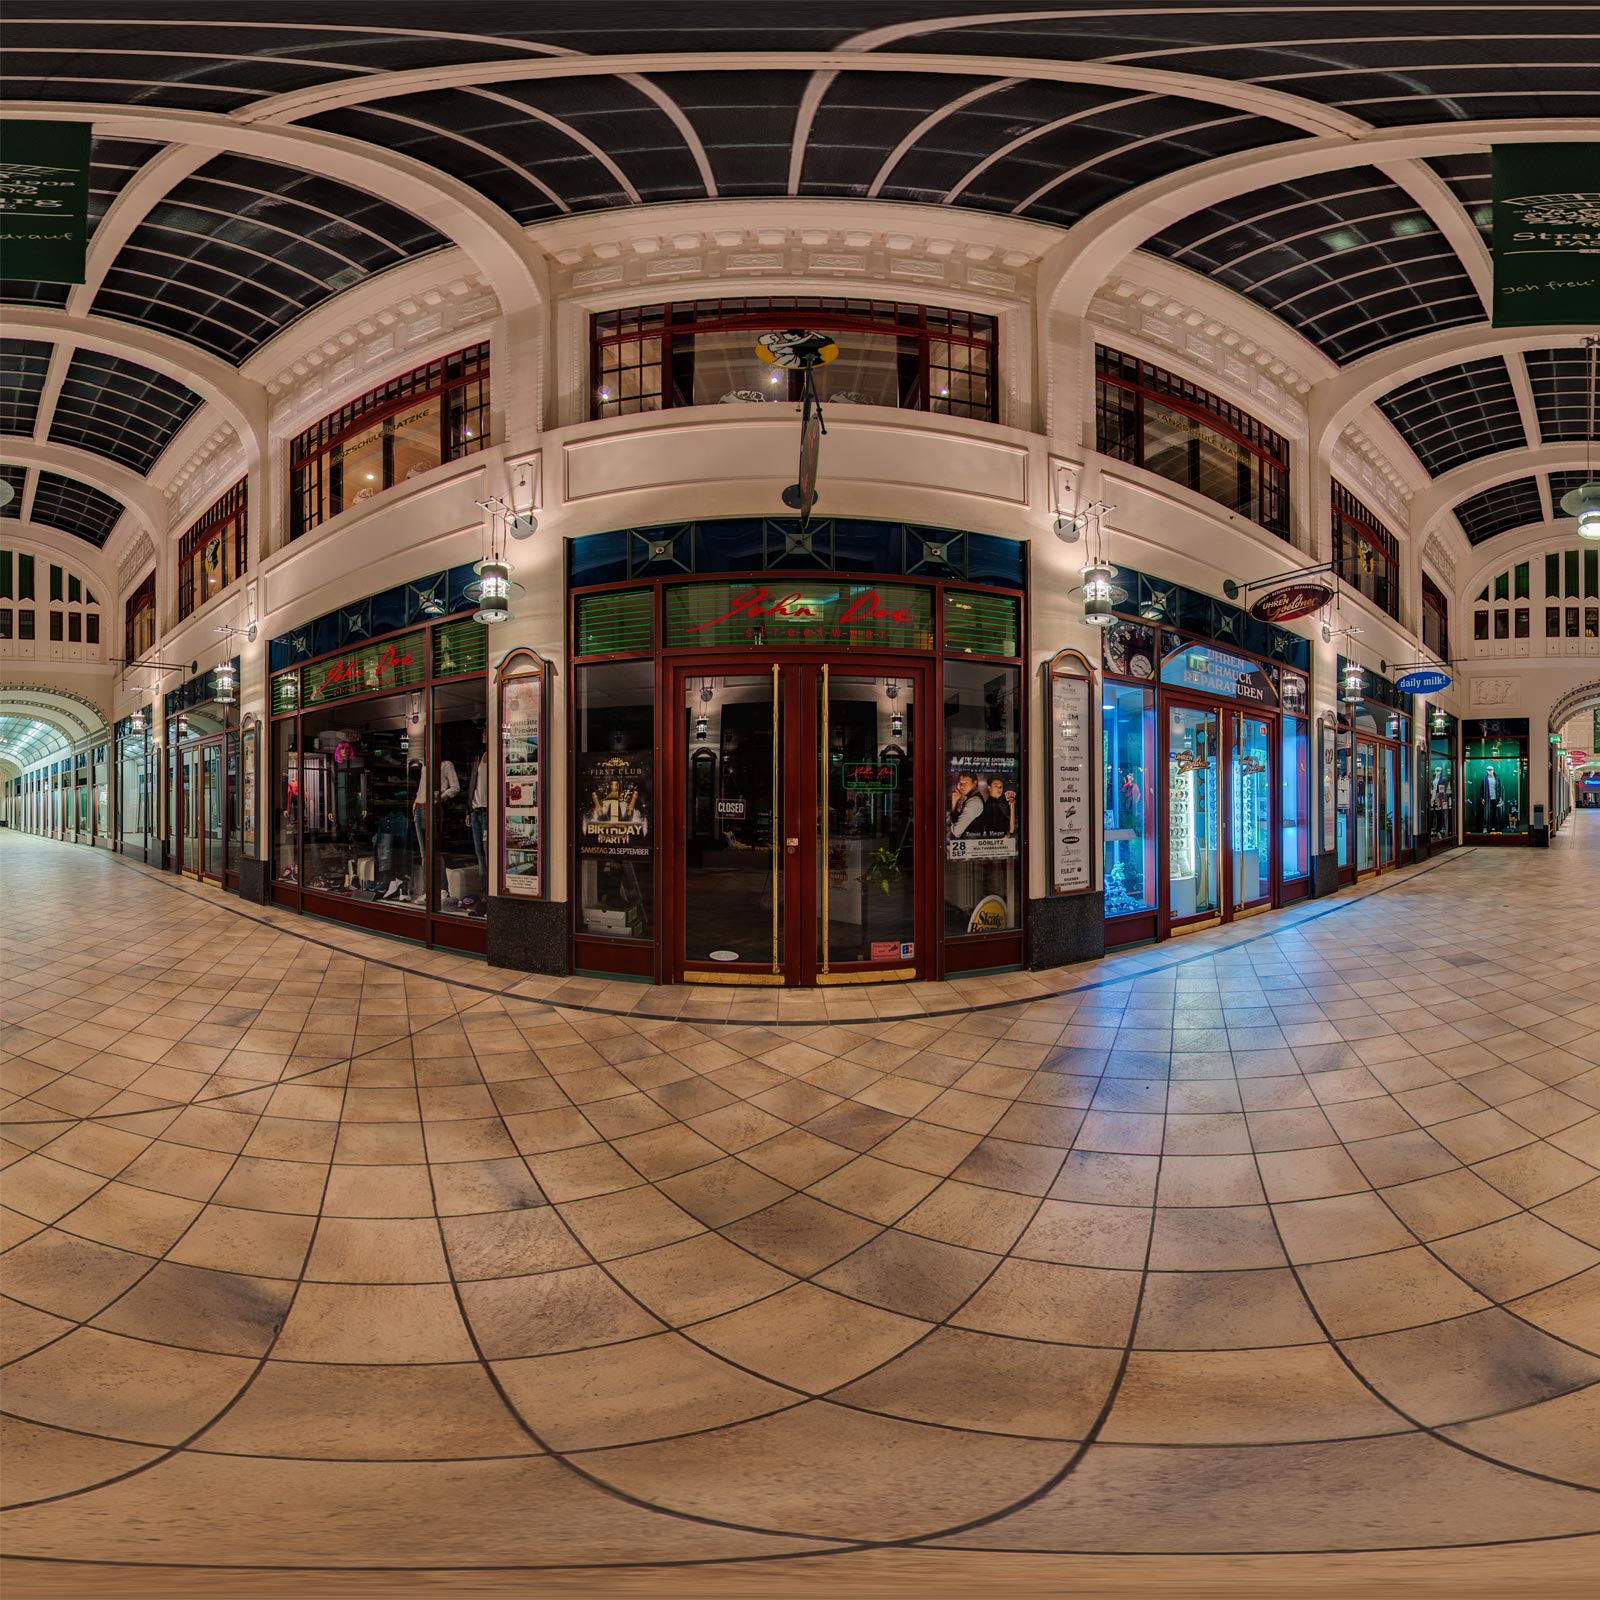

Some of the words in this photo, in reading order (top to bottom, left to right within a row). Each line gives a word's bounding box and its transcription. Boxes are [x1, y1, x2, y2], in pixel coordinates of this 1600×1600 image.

[331, 430, 387, 465] ANZSCHULE
[387, 408, 431, 434] MATZKE
[685, 587, 817, 633] John
[839, 588, 914, 625] Doe
[1262, 598, 1290, 610] UHREN
[374, 643, 415, 676] Doe
[1207, 648, 1246, 670] UHREN
[1198, 661, 1253, 685] SCHMUCK
[1183, 669, 1264, 701] REPARATUREN
[1400, 678, 1421, 689] daily
[1423, 675, 1446, 686] milk!
[590, 768, 614, 776] FIRST
[717, 802, 744, 813] CLOSED
[587, 824, 642, 835] BIRTHDAY
[600, 835, 627, 844] PARTY
[580, 846, 608, 854] SAMSTAG
[951, 842, 966, 851] 28
